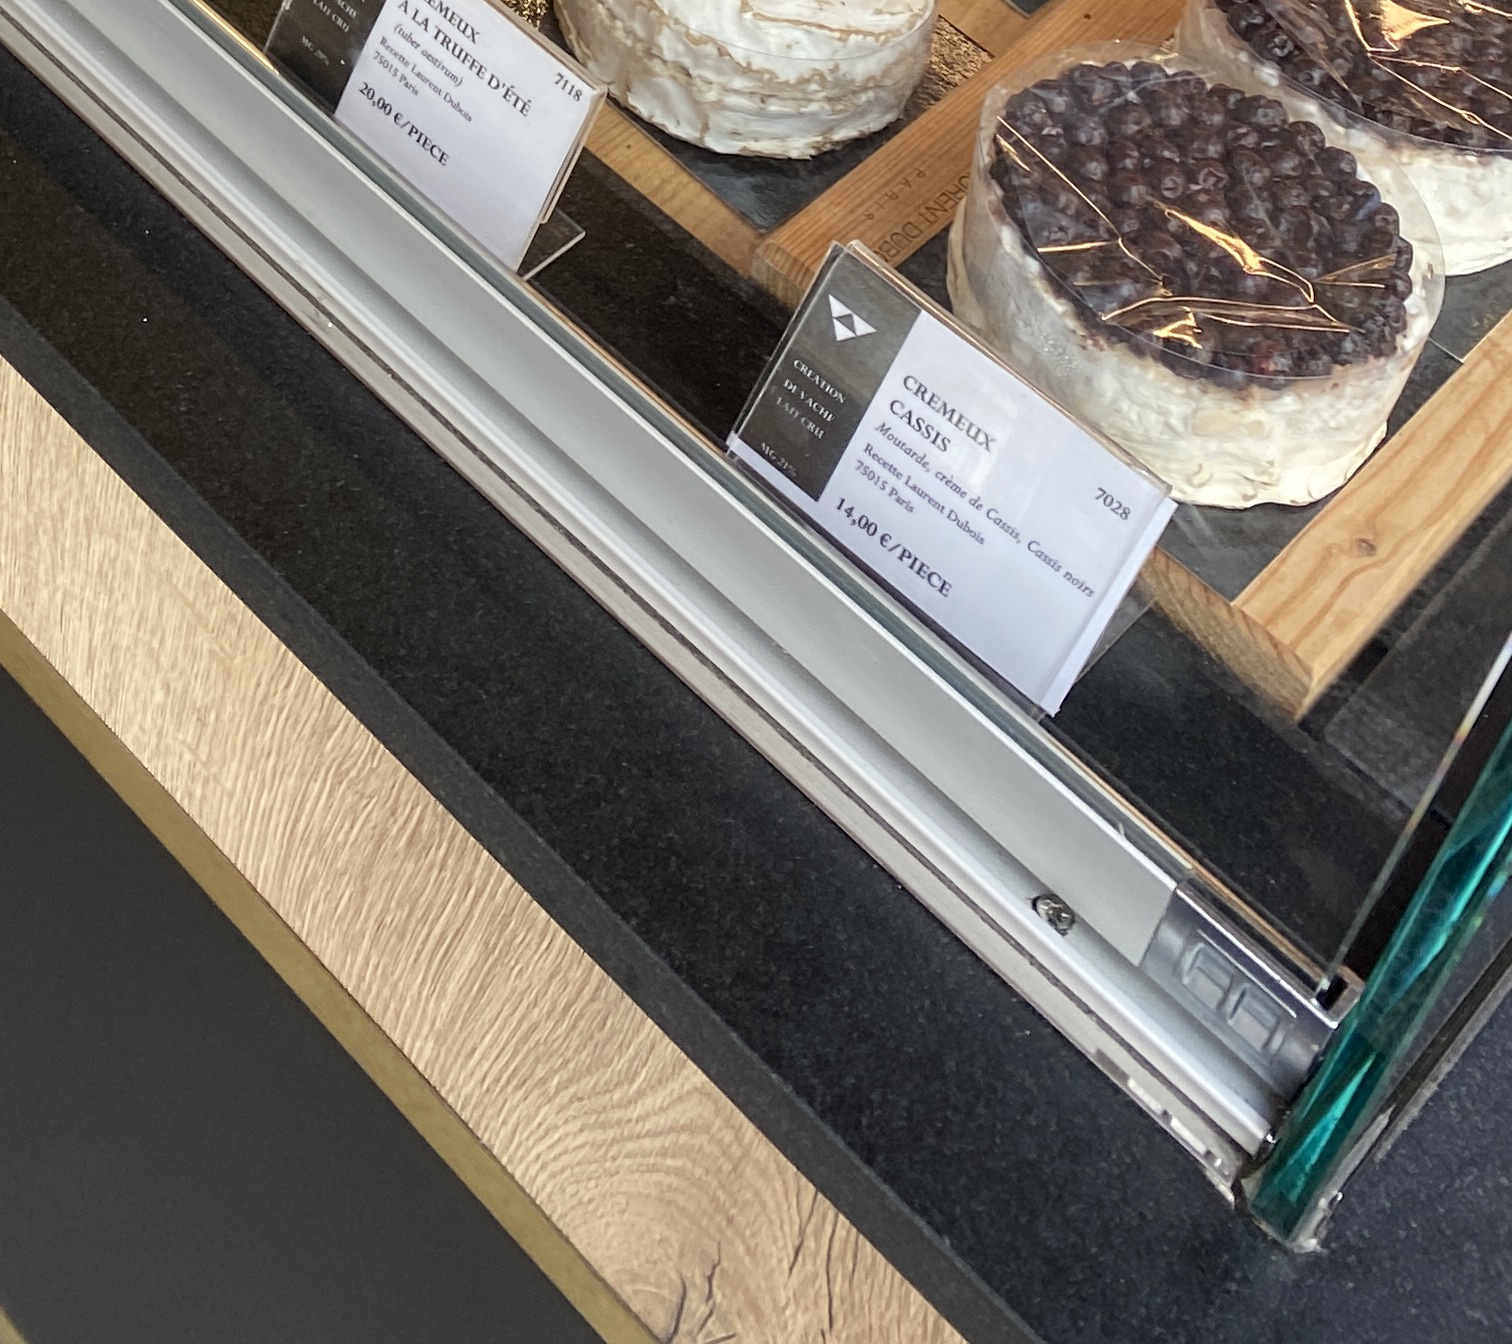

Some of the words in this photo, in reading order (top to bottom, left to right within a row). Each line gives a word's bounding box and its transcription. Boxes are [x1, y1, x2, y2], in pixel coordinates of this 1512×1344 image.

[392, 22, 421, 51] (tuber
[372, 50, 399, 77] 75015
[398, 73, 419, 96] Paris
[378, 36, 410, 68] Recette
[410, 63, 443, 96] Laurent
[442, 91, 472, 122] Dubois
[410, 8, 430, 32] LA
[431, 25, 487, 79] TRUFFE
[486, 71, 532, 117] D'ÉTÉ
[553, 72, 583, 102] 7118
[357, 81, 393, 117] 20,00
[792, 357, 845, 404] CREATION
[888, 397, 951, 453] CASSIS
[902, 372, 995, 453] CREMEUX
[854, 458, 888, 492] 75015
[887, 485, 915, 514] Paris
[863, 441, 903, 481] Recette
[903, 474, 945, 514] Laurent
[945, 508, 986, 546] Dubois
[873, 420, 932, 473] Moutarde,
[933, 468, 967, 500] crème
[967, 494, 984, 512] de
[985, 506, 1023, 545] Cassis,
[1026, 538, 1062, 573] Cassis
[1062, 569, 1095, 599] noirs
[1094, 486, 1131, 522] 7028
[834, 496, 878, 539] 14,00
